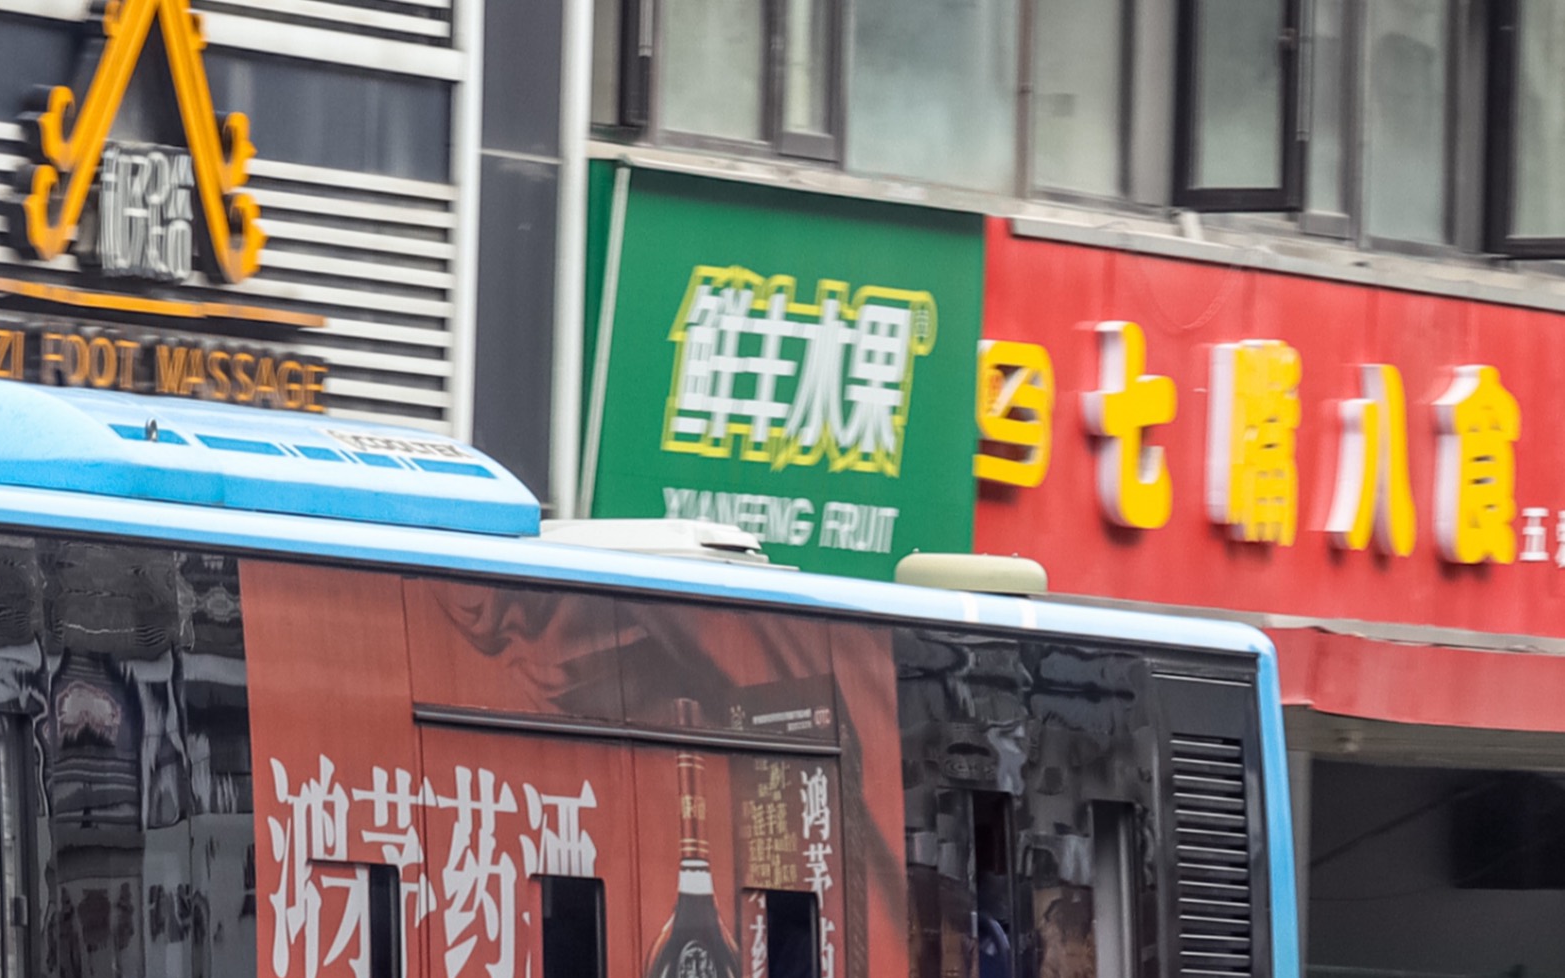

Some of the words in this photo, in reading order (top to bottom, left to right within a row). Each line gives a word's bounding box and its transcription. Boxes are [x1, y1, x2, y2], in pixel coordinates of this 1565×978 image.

[40, 332, 141, 390] FOOT
[155, 344, 329, 413] MASSAGE
[819, 501, 900, 554] FRUIT
